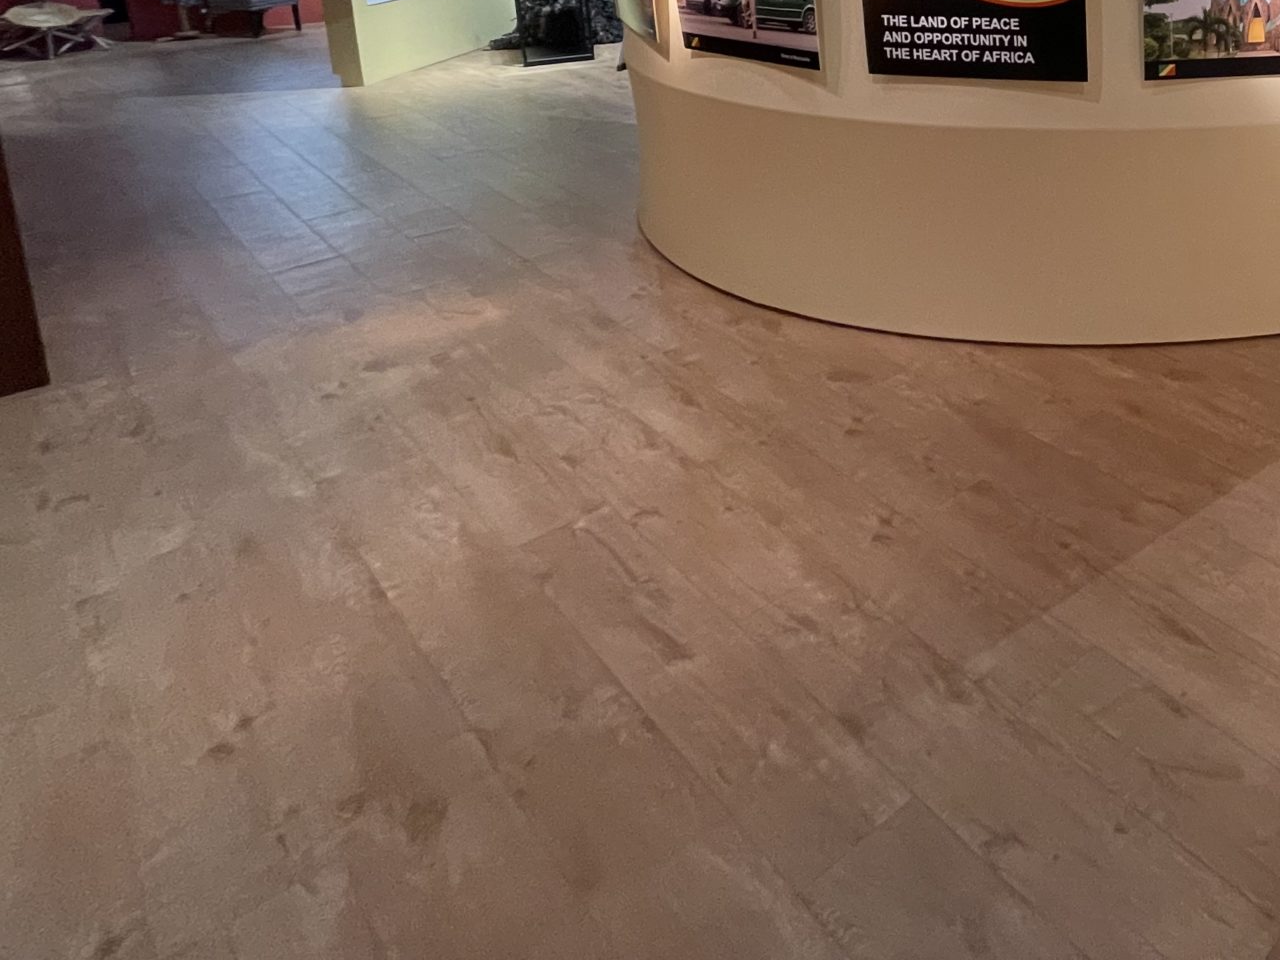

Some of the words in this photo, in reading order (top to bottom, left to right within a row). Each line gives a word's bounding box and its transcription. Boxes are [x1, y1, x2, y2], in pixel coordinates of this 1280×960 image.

[881, 15, 908, 28] THE
[910, 15, 947, 29] LAND
[950, 16, 969, 29] OF
[972, 18, 1020, 30] PEACE
[883, 31, 911, 44] AND
[914, 32, 1010, 47] OPPORTUNITY
[1013, 35, 1027, 47] IN
[884, 47, 910, 60] THE
[913, 48, 958, 61] HEART
[961, 50, 980, 62] OF
[983, 51, 1035, 64] AFRICA
